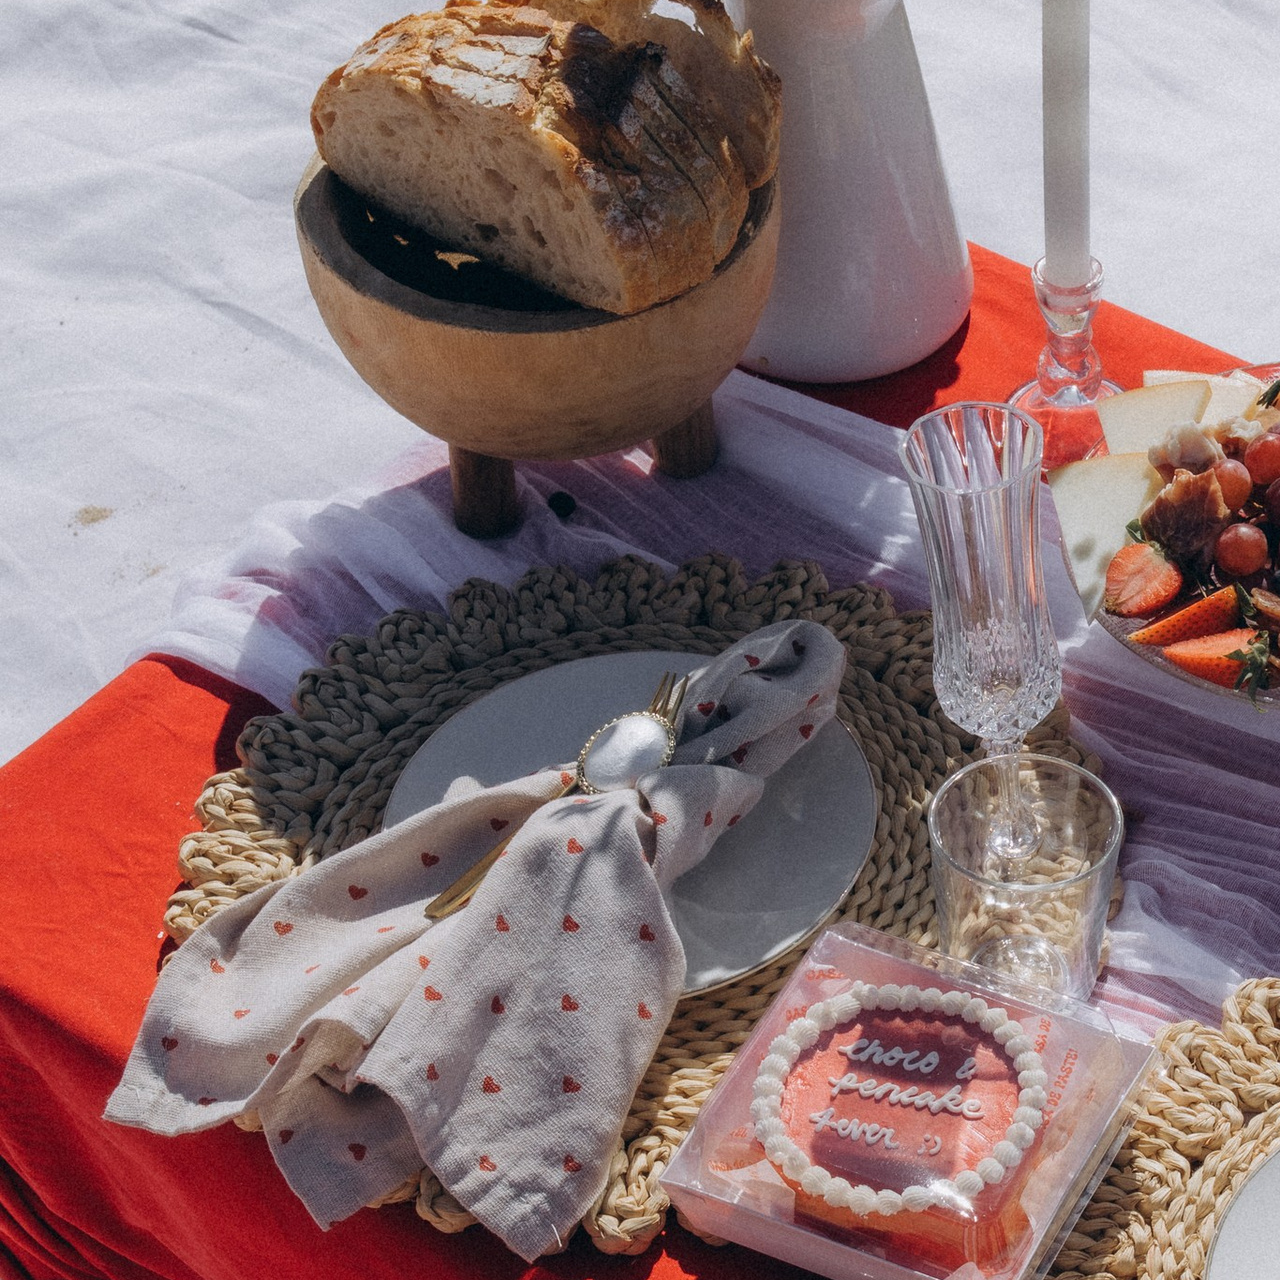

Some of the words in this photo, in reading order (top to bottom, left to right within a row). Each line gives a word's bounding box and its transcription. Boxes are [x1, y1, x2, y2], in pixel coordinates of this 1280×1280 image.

[838, 1038, 940, 1072] choco
[955, 1057, 977, 1079] &
[1046, 1090, 1062, 1107] DE
[809, 1107, 899, 1149] 4ever
